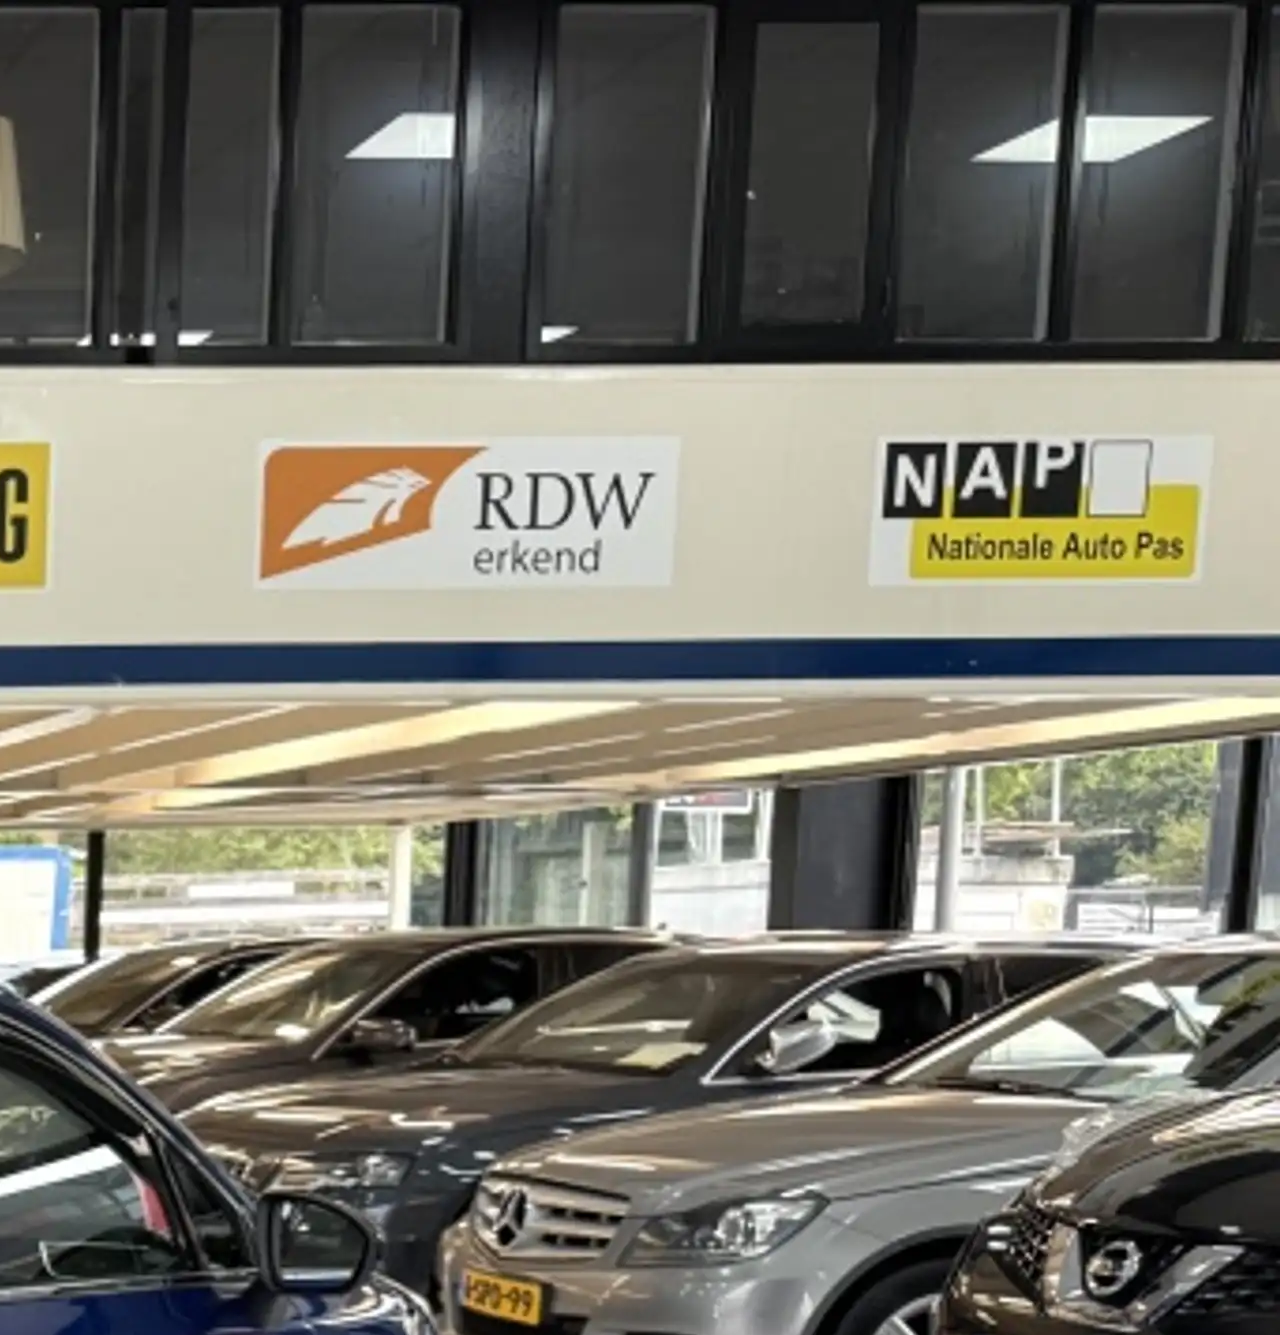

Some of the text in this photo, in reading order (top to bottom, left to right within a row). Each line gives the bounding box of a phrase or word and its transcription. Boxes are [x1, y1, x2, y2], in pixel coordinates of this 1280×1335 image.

[892, 441, 1076, 507] NAP
[473, 472, 657, 530] RDW
[472, 538, 603, 575] erkend
[927, 532, 1185, 561] Nationale Auto Pas
